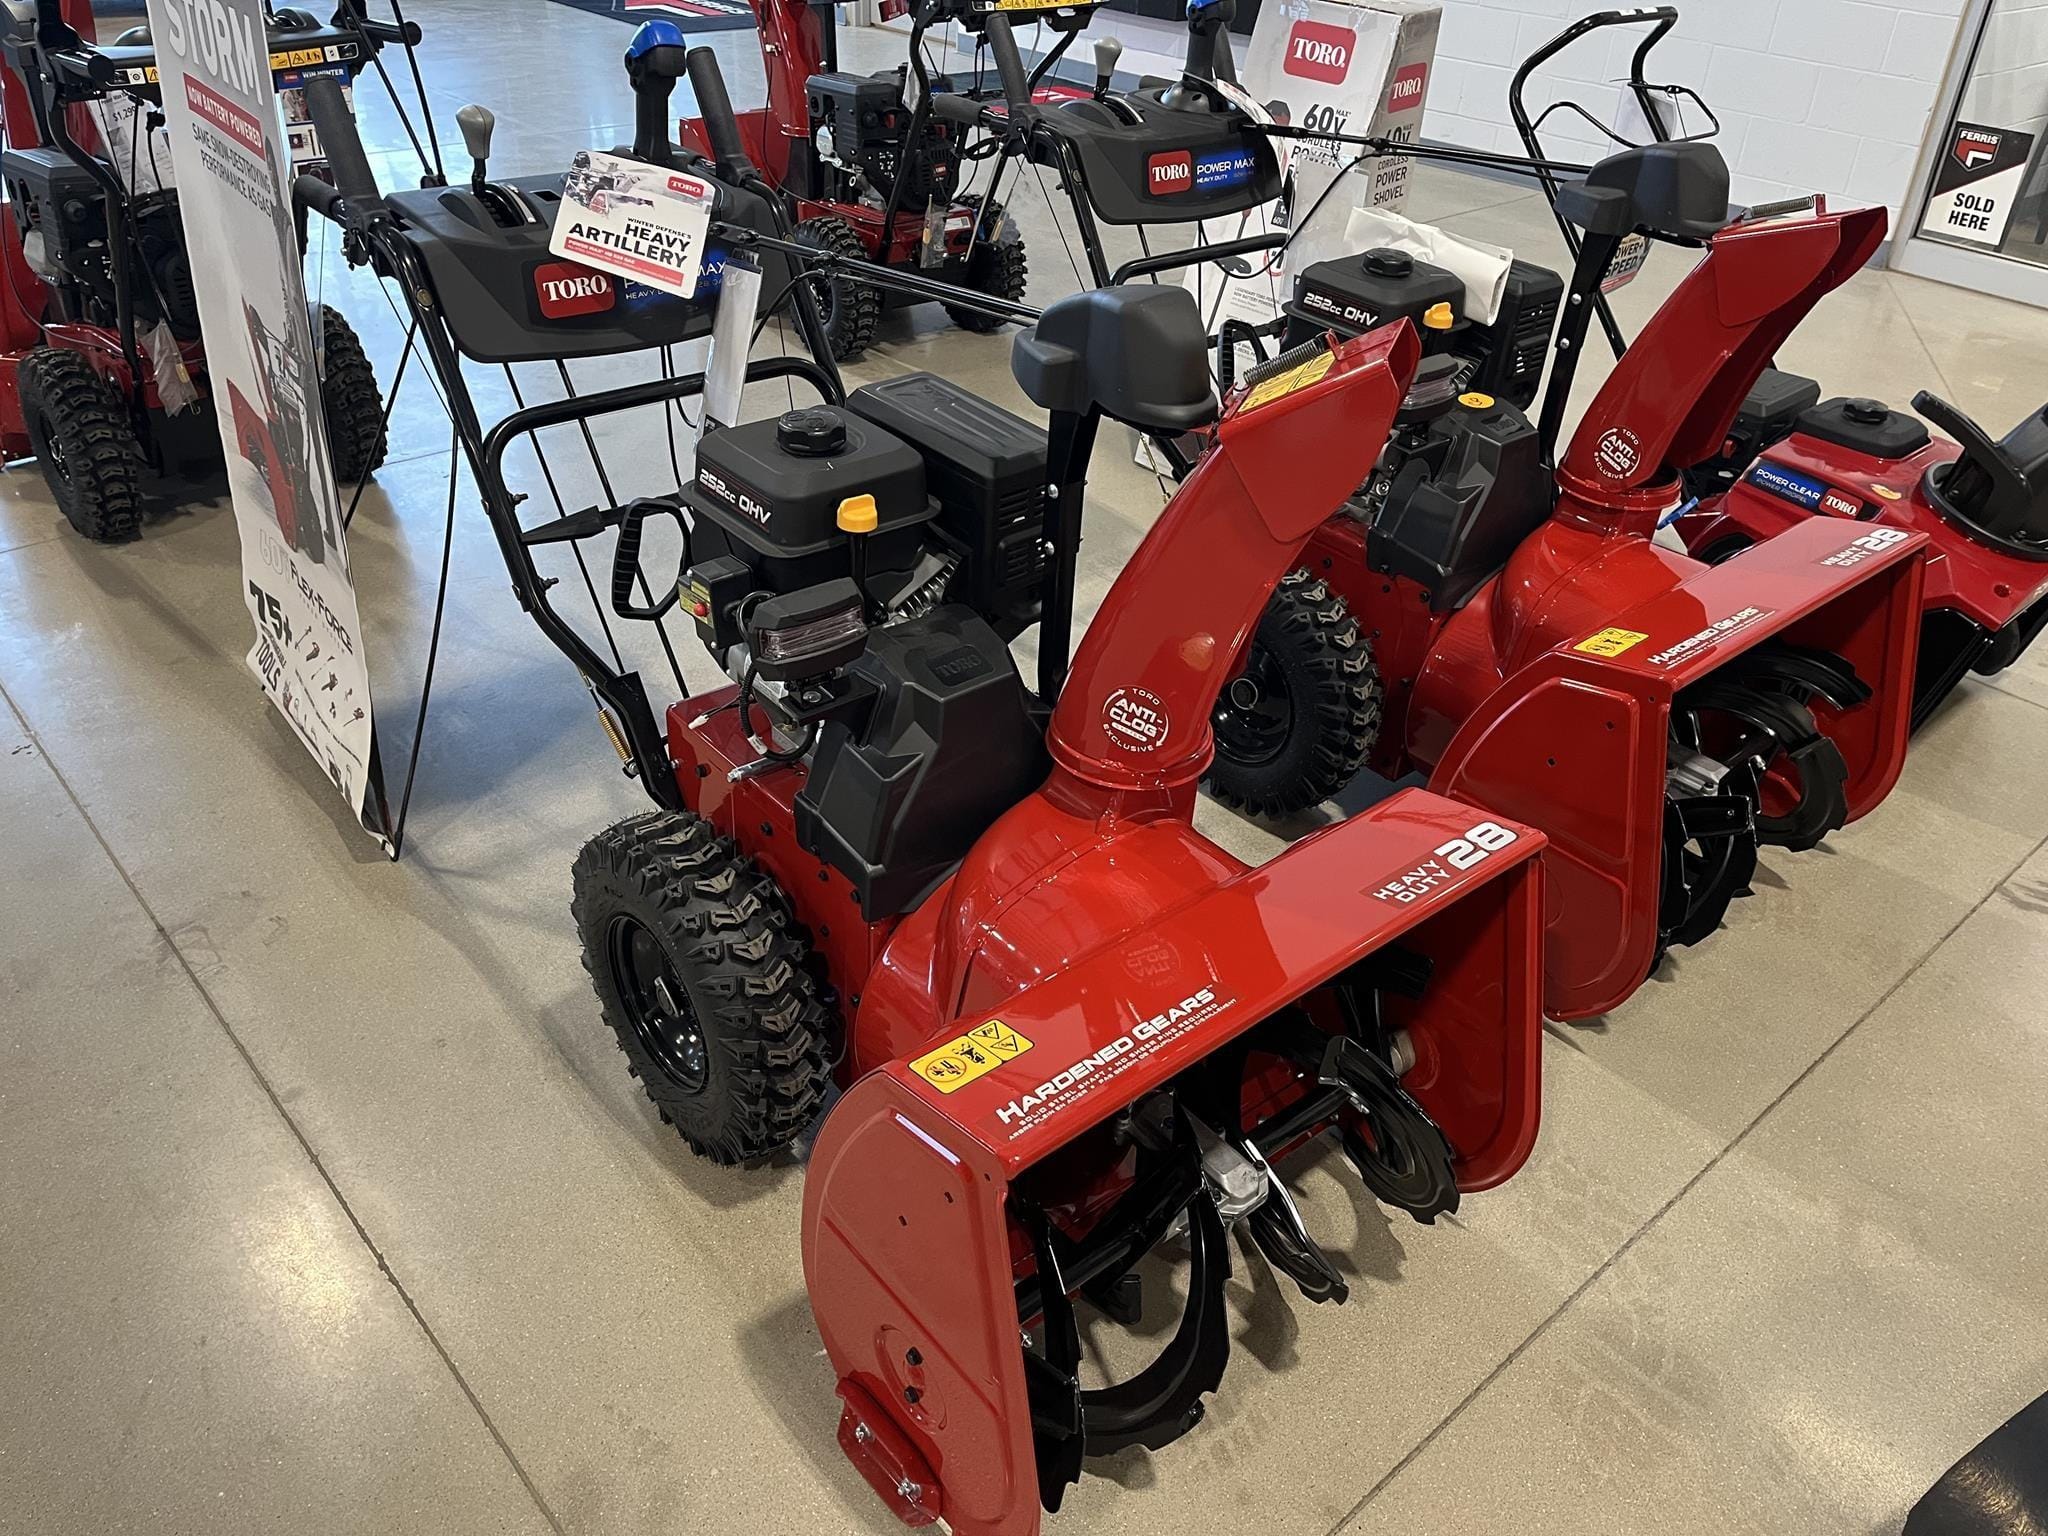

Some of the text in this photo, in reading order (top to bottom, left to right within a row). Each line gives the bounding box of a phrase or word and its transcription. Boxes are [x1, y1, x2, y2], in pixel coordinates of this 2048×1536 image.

[163, 0, 263, 105] STORM
[1294, 38, 1347, 68] TORO
[1392, 77, 1421, 100] TORO
[202, 93, 230, 126] BATTERY
[229, 111, 262, 149] POWERED
[1960, 130, 1999, 144] FERRIS
[192, 122, 212, 149] SAME
[210, 134, 272, 195] SNOW-DESTROYING
[1152, 163, 1189, 182] TORO
[1196, 160, 1232, 176] POWER
[1234, 157, 1255, 170] MAX
[1378, 156, 1409, 170] CORDLESS
[200, 149, 248, 200] PERFORMANCE
[247, 184, 258, 207] AS
[257, 191, 272, 218] GAS
[670, 180, 701, 193] TORO
[1376, 166, 1408, 188] POWER
[1373, 184, 1405, 206] SHOVEL
[1953, 192, 1995, 214] SOLD
[627, 216, 692, 240] WINTER DEFENSE'S
[1948, 210, 1990, 232] HERE
[568, 222, 688, 268] ARTILLERY
[624, 223, 690, 252] HEAVY
[542, 274, 609, 302] TORO
[625, 289, 656, 300] HEAVY
[1304, 292, 1378, 326] 252cc OHV
[1622, 429, 1639, 446] TORO
[1594, 452, 1624, 479] EXCLUSIVE
[1601, 440, 1630, 469] CLOG
[699, 468, 772, 524] 252cc OHV
[1756, 468, 1821, 500] POWER CLEAR
[1826, 495, 1857, 516] TORO
[1851, 528, 1909, 552] 28
[1820, 546, 1862, 566] HEAVY
[1836, 550, 1872, 566] DUTY
[249, 579, 293, 648] 75+
[1647, 628, 1720, 664] HARDENED
[256, 634, 281, 692] TOOLS
[1114, 698, 1163, 724] ANTI-
[1132, 688, 1160, 706] TORO
[1109, 706, 1158, 738] CLOG
[1102, 723, 1154, 752] EXCLUSIVE
[1433, 820, 1518, 871] 28
[1372, 859, 1441, 900] HEAVY
[1394, 868, 1451, 903] DUTY
[1018, 1105, 1046, 1126] SOLID
[1048, 1090, 1078, 1110] STEEL
[1077, 1071, 1106, 1092] SHAFT
[1114, 1056, 1128, 1068] NO
[1157, 1026, 1178, 1042] PINS
[1177, 1002, 1218, 1030] REQUIRED
[995, 1036, 1135, 1125] HARDENED
[1008, 1122, 1034, 1141] ARBRE
[1034, 1108, 1056, 1125] PLEIN
[1056, 1100, 1068, 1111] EN
[1066, 1088, 1089, 1105] ACIER
[1098, 1074, 1114, 1085] PAS
[1113, 1058, 1140, 1077] BESOIN
